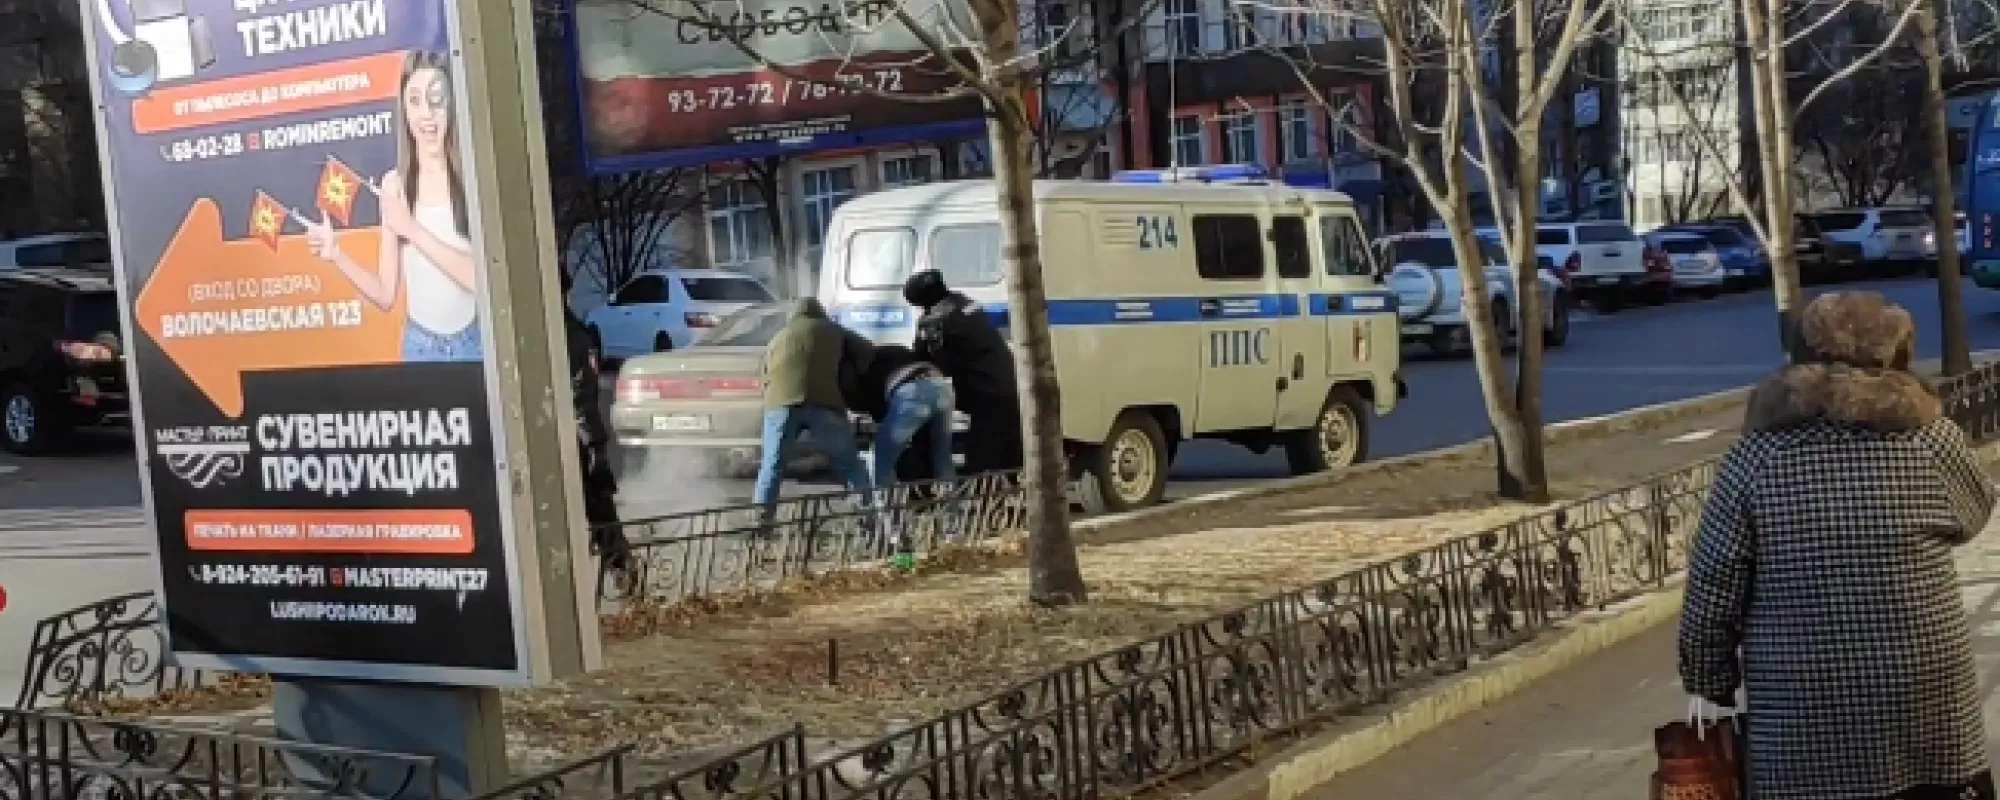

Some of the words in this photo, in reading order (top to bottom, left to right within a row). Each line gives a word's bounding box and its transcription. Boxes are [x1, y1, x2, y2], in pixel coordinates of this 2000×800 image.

[237, 0, 386, 57] ТЕХНИКИ
[668, 81, 774, 112] 93-72-72
[1136, 215, 1178, 251] 214
[188, 278, 235, 303] (ВХОД
[237, 277, 259, 299] СО
[262, 274, 321, 298] ДВОРА)
[160, 304, 324, 337] ВОЛОЧАЕВСКАЯ
[328, 299, 362, 327] 123
[1210, 326, 1271, 367] ППС
[257, 408, 472, 449] СУВЕНИРНАЯ
[261, 451, 459, 497] ПРОДУКЦИЯ
